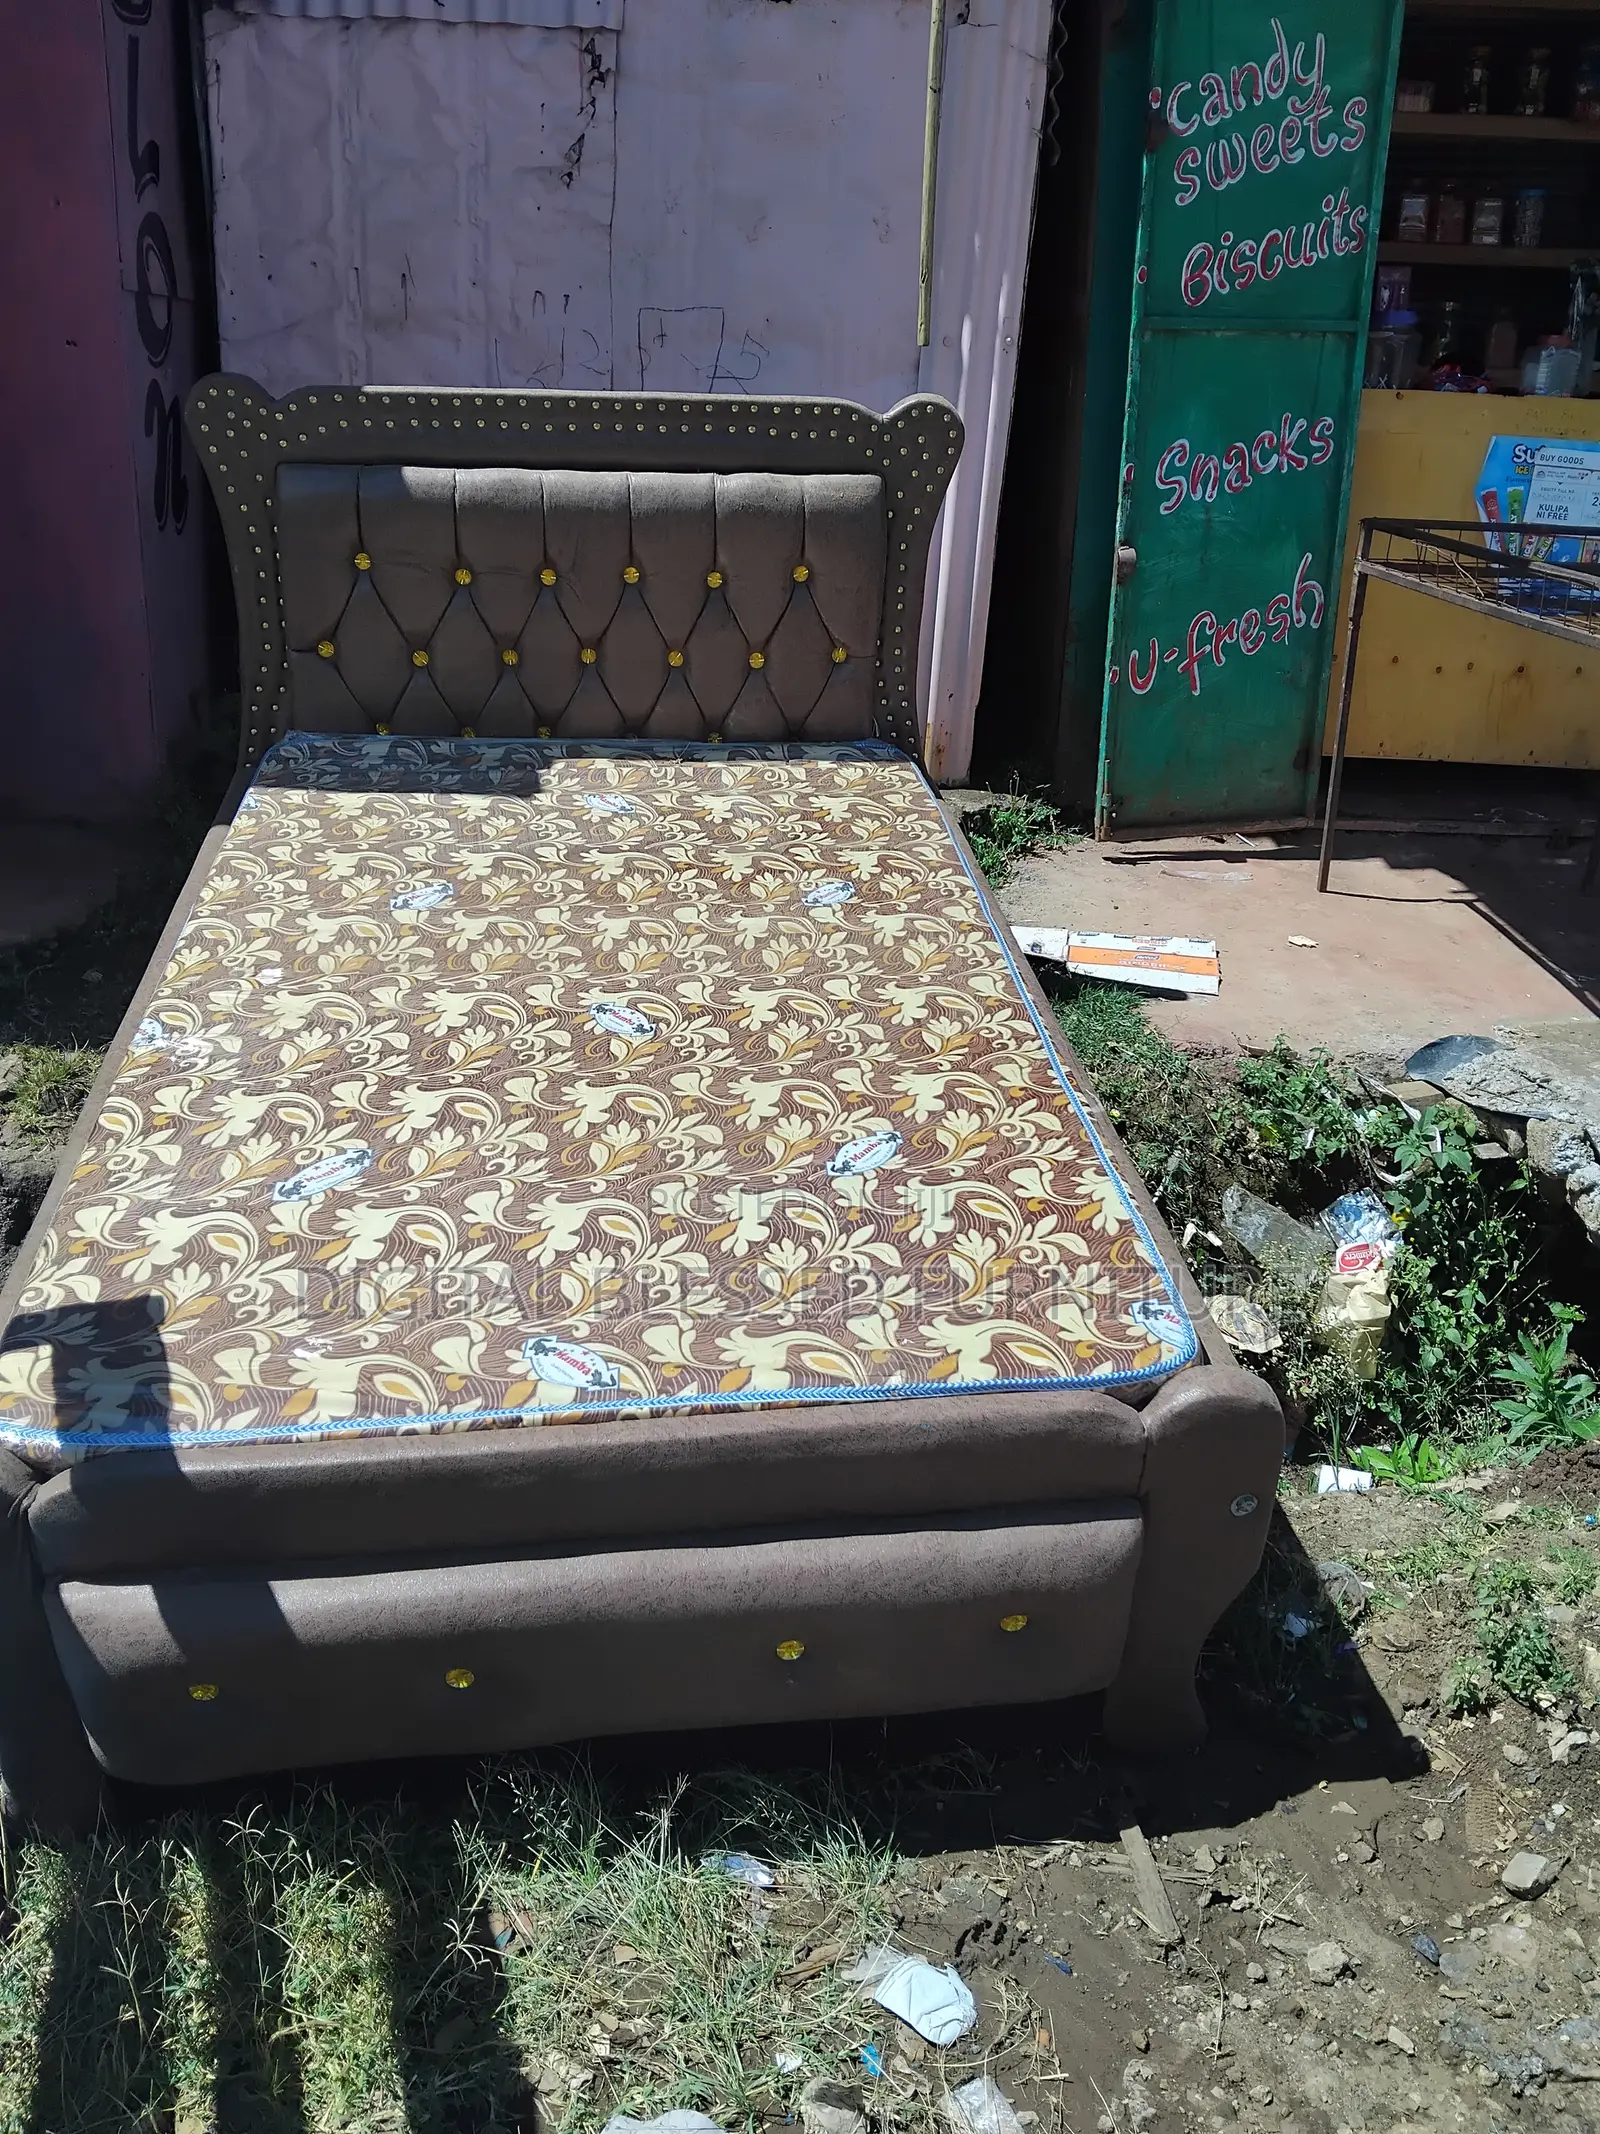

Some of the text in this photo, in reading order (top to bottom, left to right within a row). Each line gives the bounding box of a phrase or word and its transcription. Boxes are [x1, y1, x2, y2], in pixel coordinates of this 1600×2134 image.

[1181, 186, 1369, 308] Biscuits
[1155, 412, 1335, 515] Snacks
[1540, 453, 1585, 465] BUY GOODS
[1515, 465, 1530, 475] ICE
[1536, 511, 1569, 521] NI FREE
[1538, 503, 1569, 513] KULIPA
[849, 1140, 883, 1163] Mamba
[303, 1163, 347, 1183] Mamba
[554, 1350, 592, 1376] Mamba
